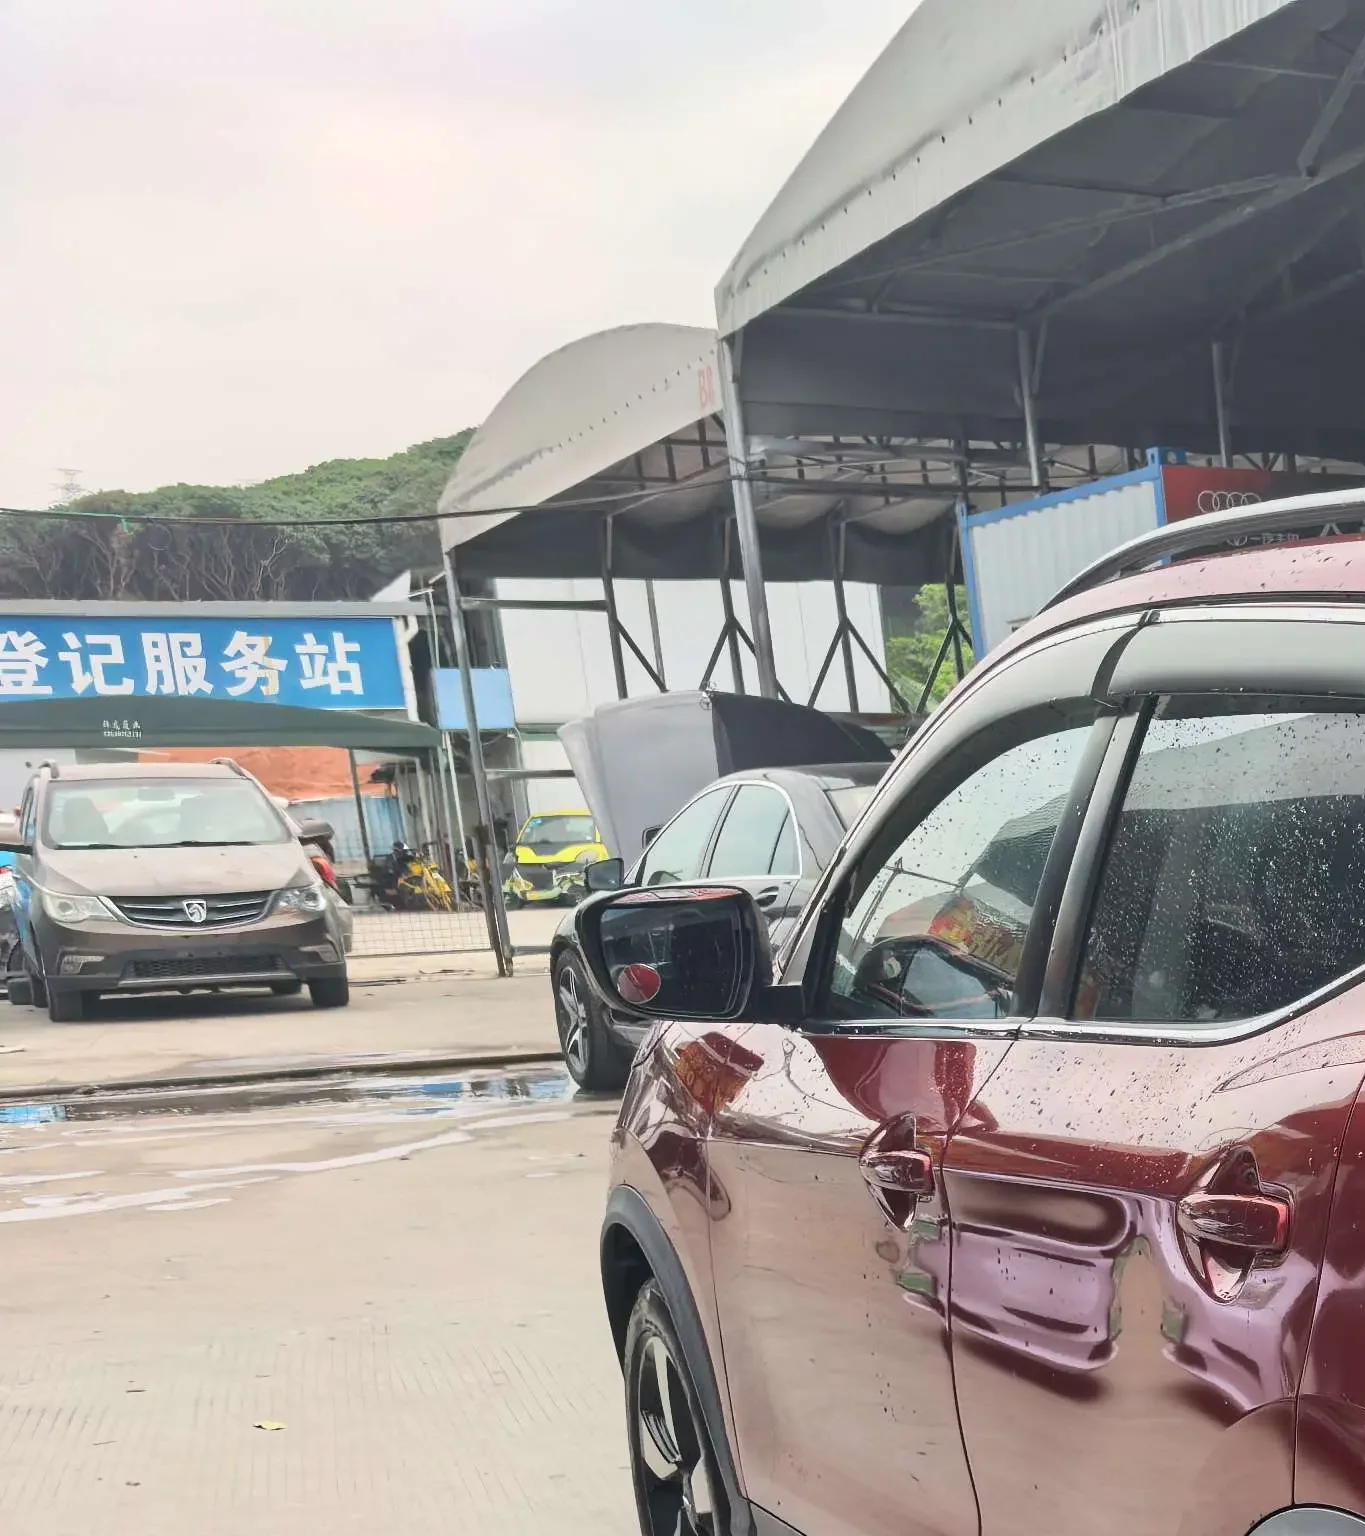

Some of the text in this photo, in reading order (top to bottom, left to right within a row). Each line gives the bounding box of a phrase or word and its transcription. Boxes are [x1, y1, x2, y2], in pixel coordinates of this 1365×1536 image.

[0, 630, 364, 696] 登记服务站
